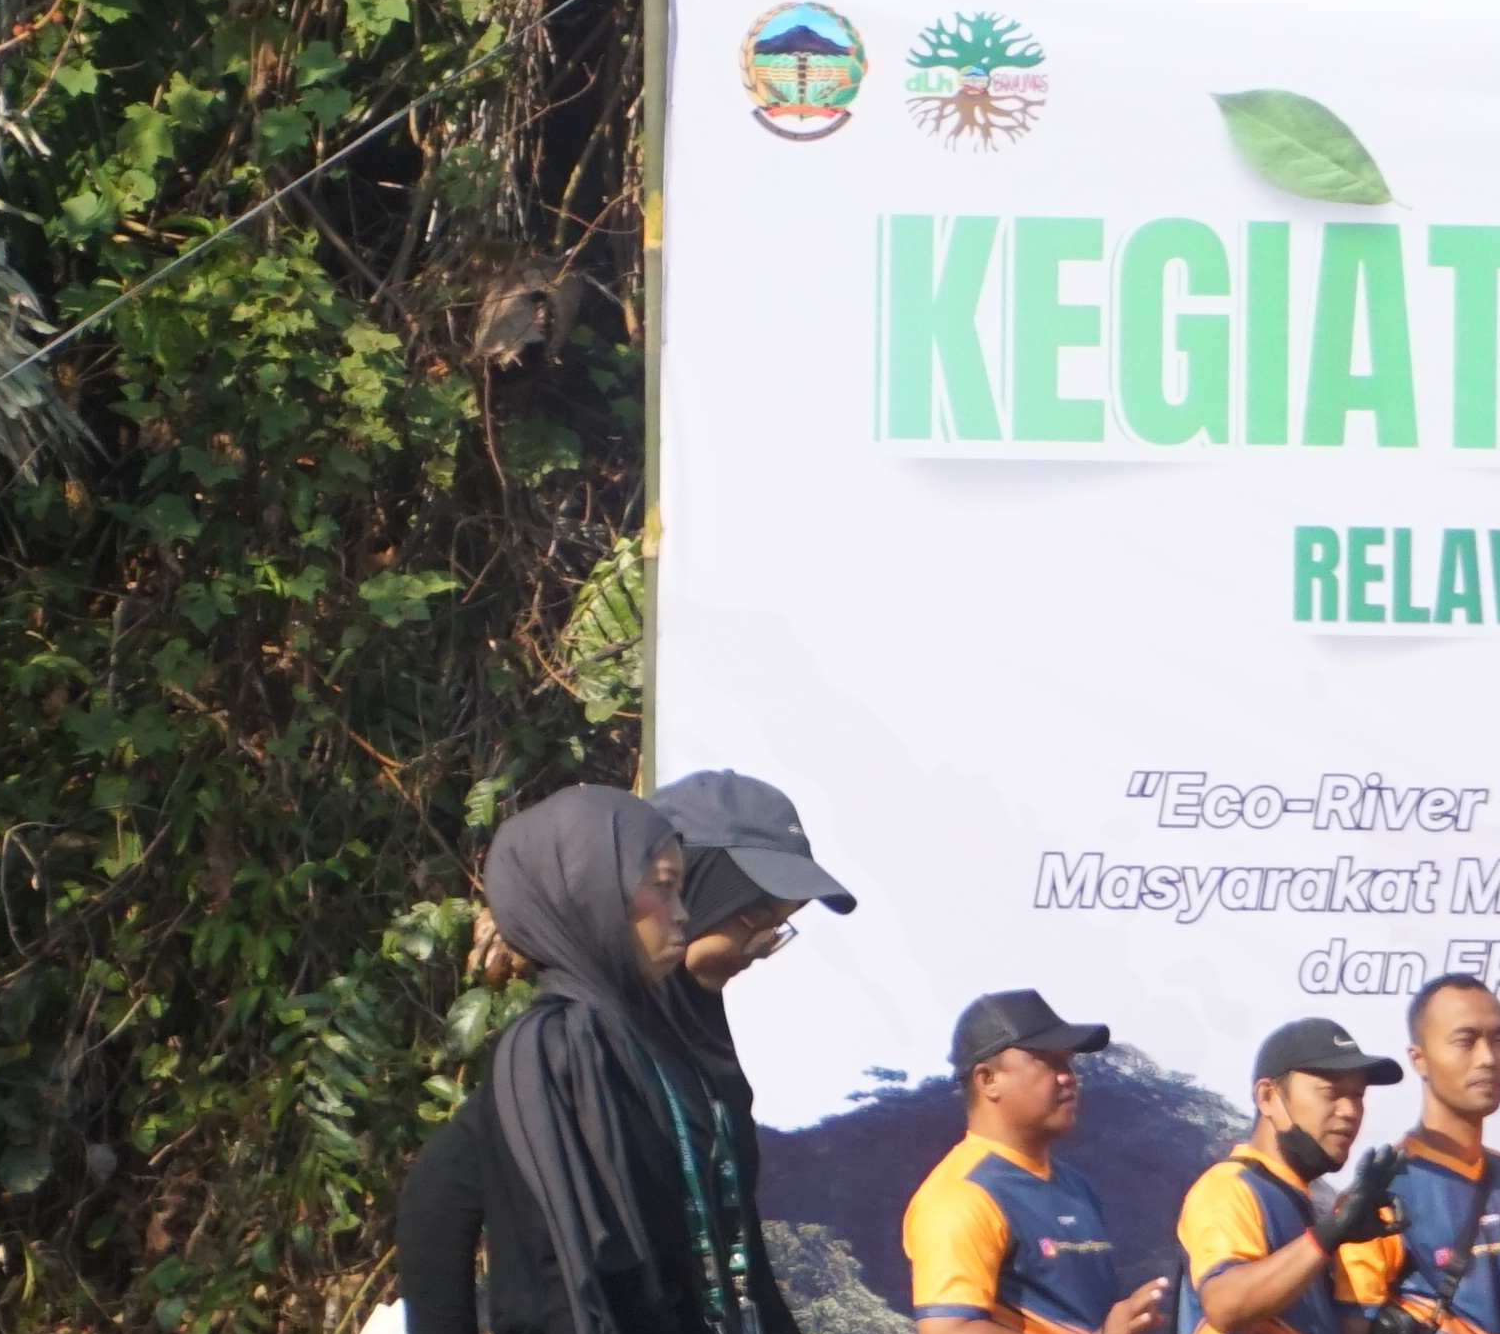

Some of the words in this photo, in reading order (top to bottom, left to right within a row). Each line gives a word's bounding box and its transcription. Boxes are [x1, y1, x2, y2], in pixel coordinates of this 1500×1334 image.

[1126, 770, 1489, 832] "Eco-River
[1034, 851, 1440, 924] Masyarakat
[1299, 938, 1426, 995] dan
